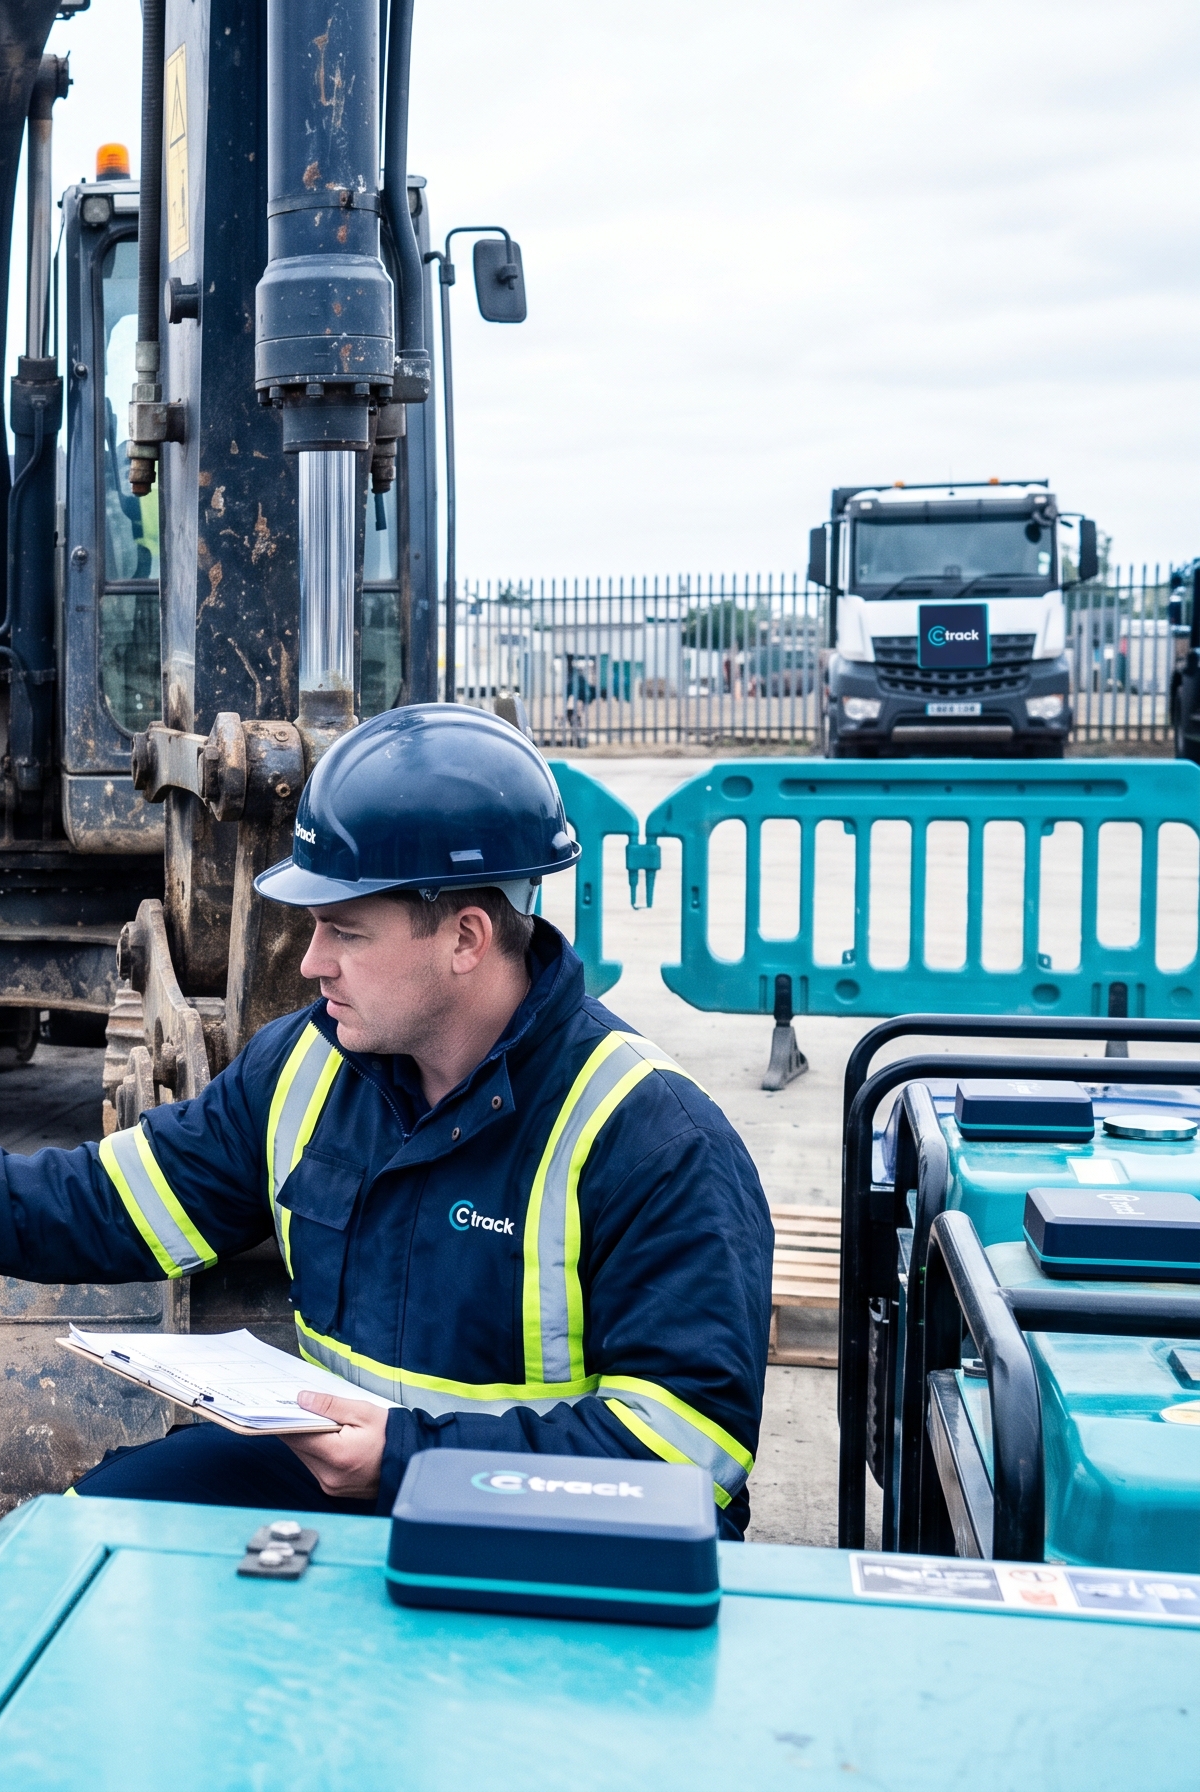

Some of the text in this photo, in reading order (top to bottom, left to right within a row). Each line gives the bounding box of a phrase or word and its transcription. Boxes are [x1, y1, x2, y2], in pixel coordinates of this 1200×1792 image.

[927, 625, 980, 646] Ctrack
[449, 1200, 515, 1235] Ctrack
[471, 1470, 644, 1498] Ctrack
